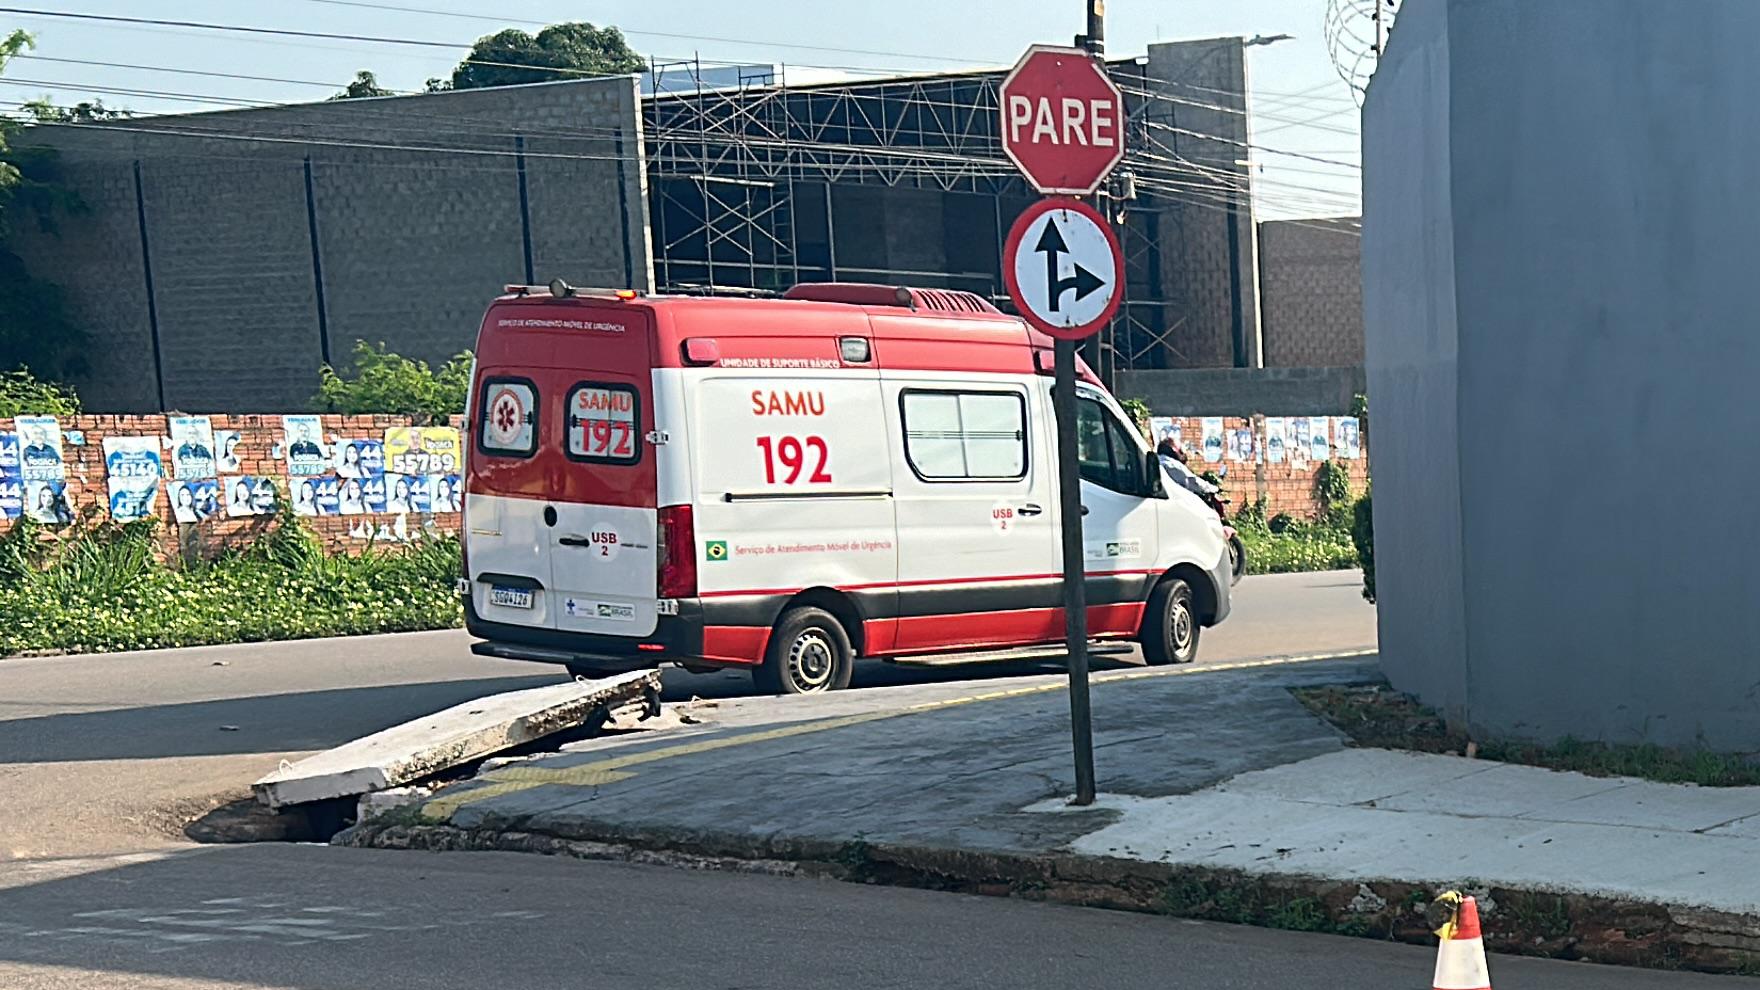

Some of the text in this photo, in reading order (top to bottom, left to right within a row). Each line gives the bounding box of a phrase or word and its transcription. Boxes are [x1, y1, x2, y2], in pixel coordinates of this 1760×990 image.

[1009, 95, 1114, 147] PARE
[720, 358, 759, 367] UNIDADE
[760, 359, 771, 367] DE
[772, 359, 808, 368] SUPORTE
[579, 391, 632, 412] SAMU
[751, 389, 825, 416] SAMU
[580, 419, 631, 454] 192
[393, 453, 456, 473] 55789
[756, 435, 832, 485] 192
[993, 509, 1013, 519] USB
[1001, 521, 1007, 529] 2
[592, 532, 617, 544] USB
[601, 545, 609, 556] 2
[735, 540, 892, 556] Serviço de Atendimento Móvel de Urgência
